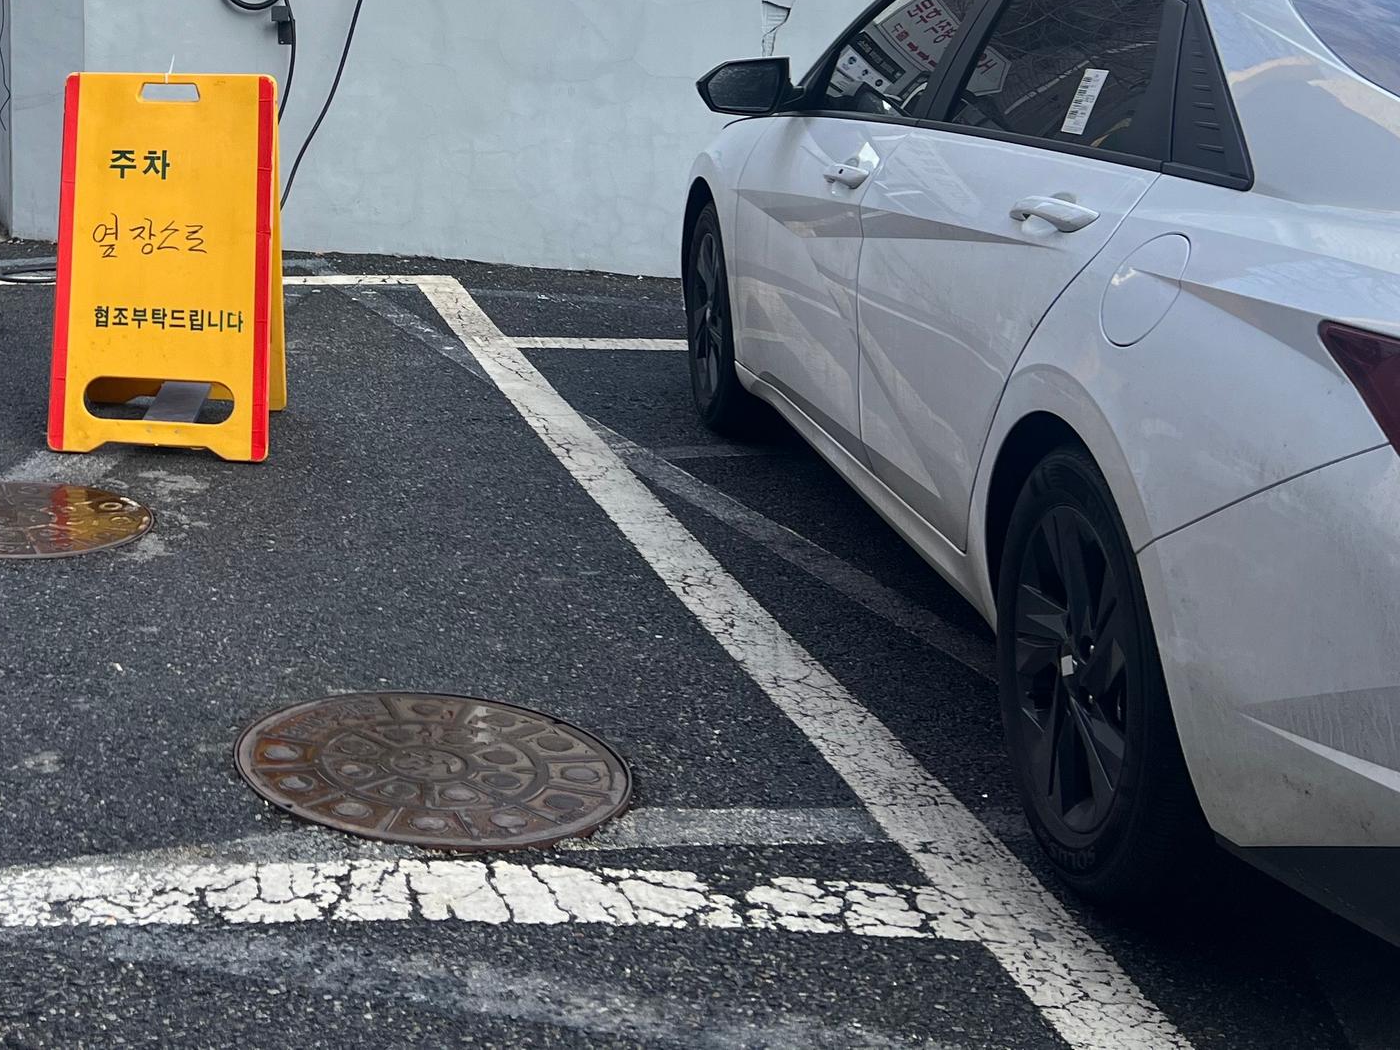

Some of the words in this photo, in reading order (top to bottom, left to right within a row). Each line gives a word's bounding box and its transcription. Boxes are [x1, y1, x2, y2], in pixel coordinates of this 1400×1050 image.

[109, 149, 171, 180] 주차
[92, 212, 119, 259] 옆
[128, 217, 208, 256] 장소로
[94, 305, 244, 333] 협조부탁드립니다
